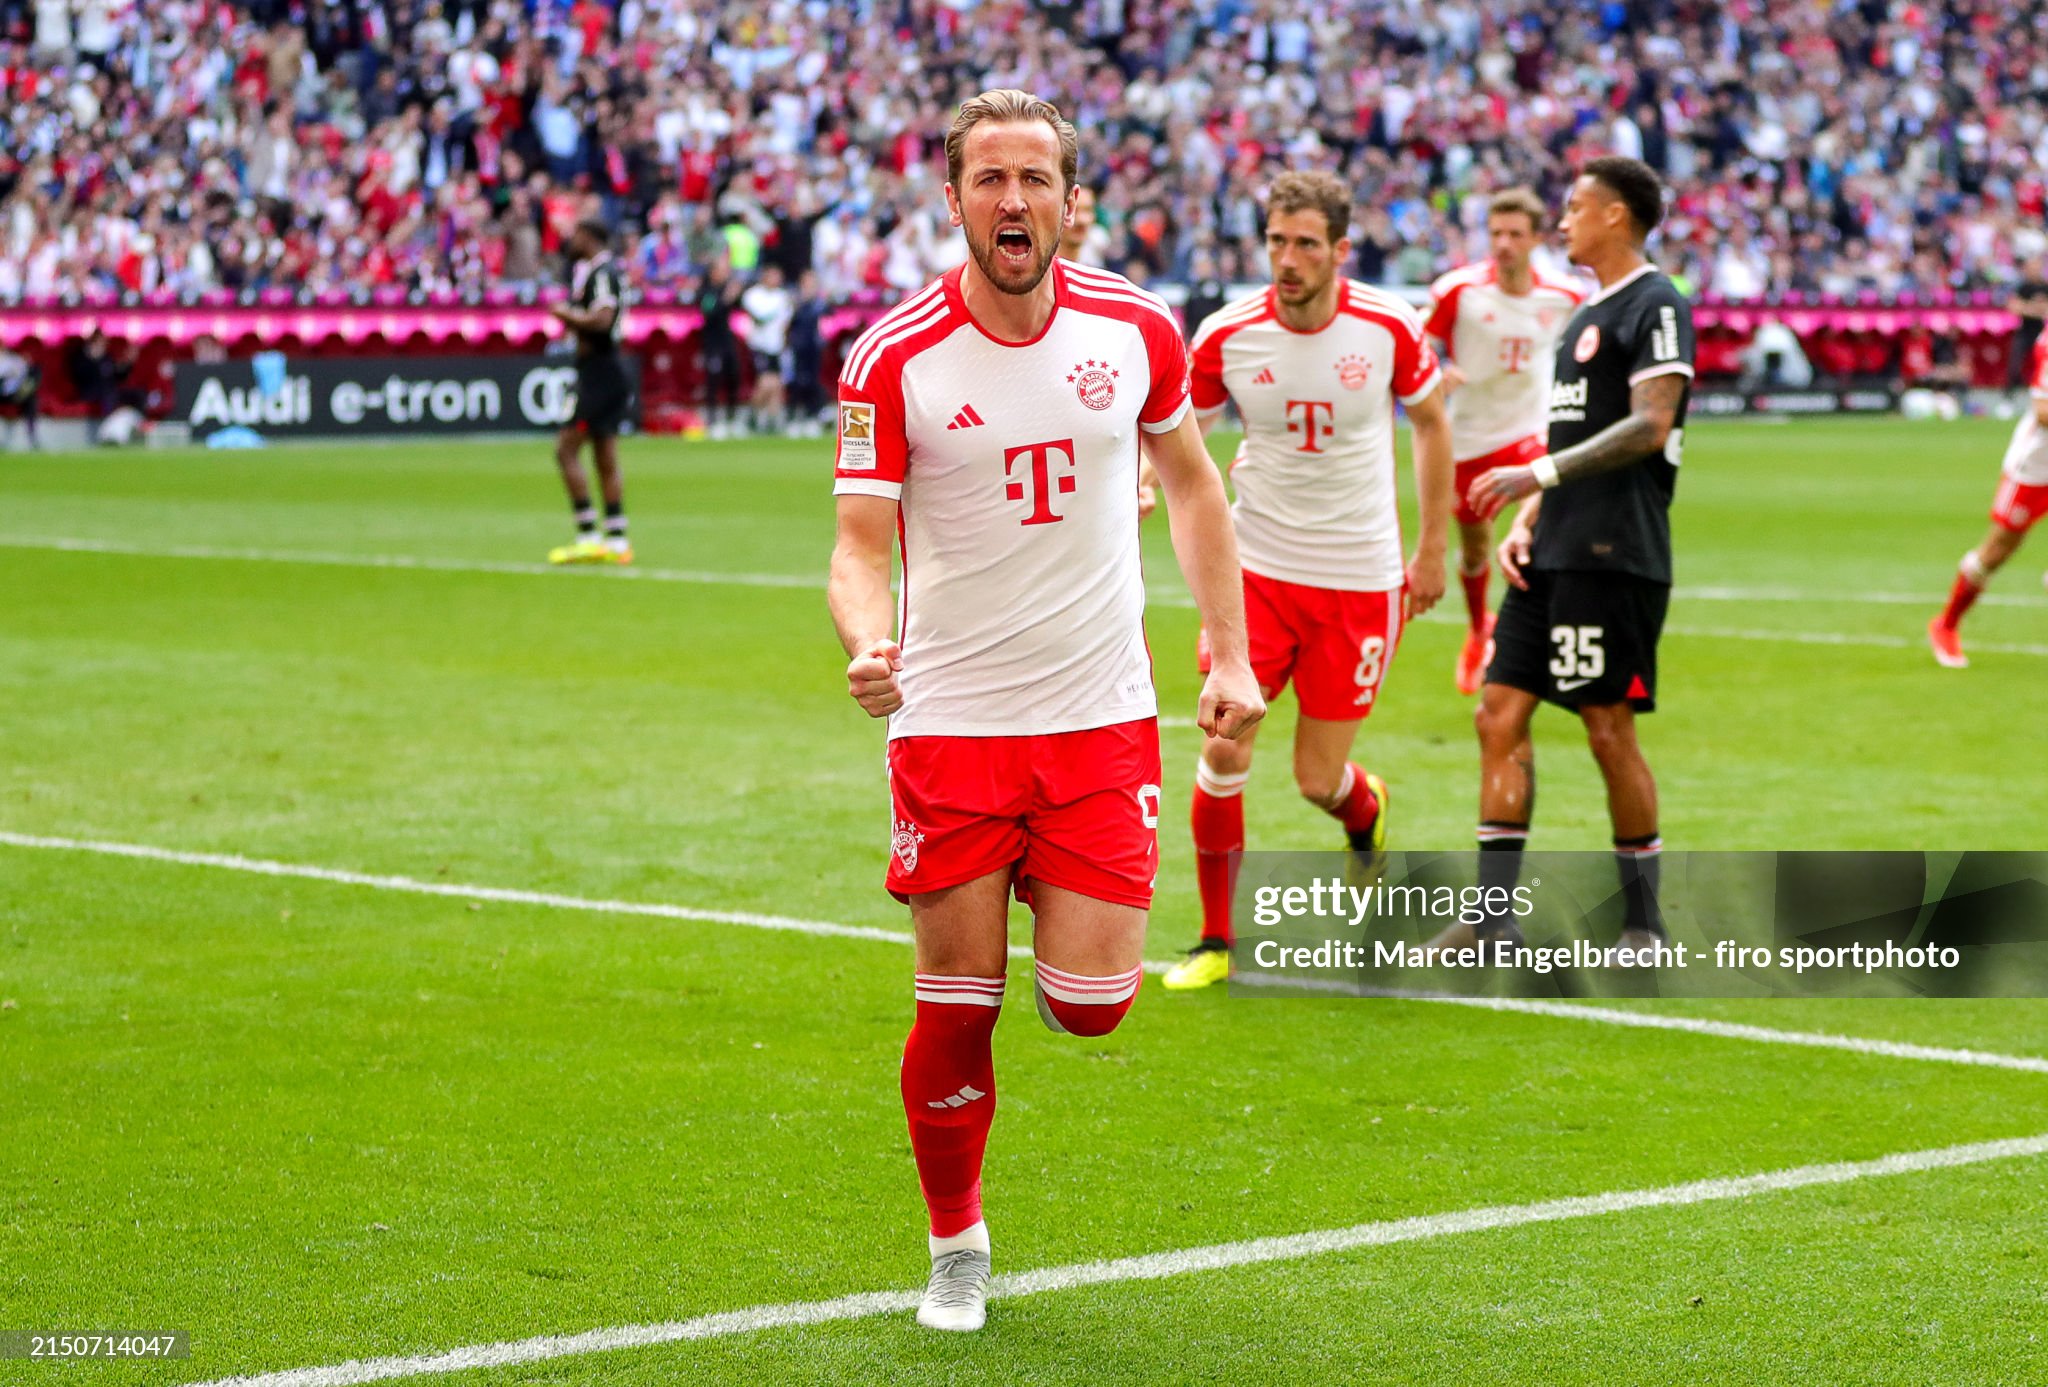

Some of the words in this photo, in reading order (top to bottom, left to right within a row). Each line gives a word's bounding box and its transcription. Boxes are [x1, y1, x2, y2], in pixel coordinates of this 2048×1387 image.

[189, 376, 311, 425] Audi
[330, 374, 501, 424] e-tron
[1085, 373, 1112, 387] BAYERN
[1286, 400, 1334, 454] T
[1004, 438, 1075, 526] T
[1353, 635, 1385, 687] 8
[1549, 625, 1605, 678] 35
